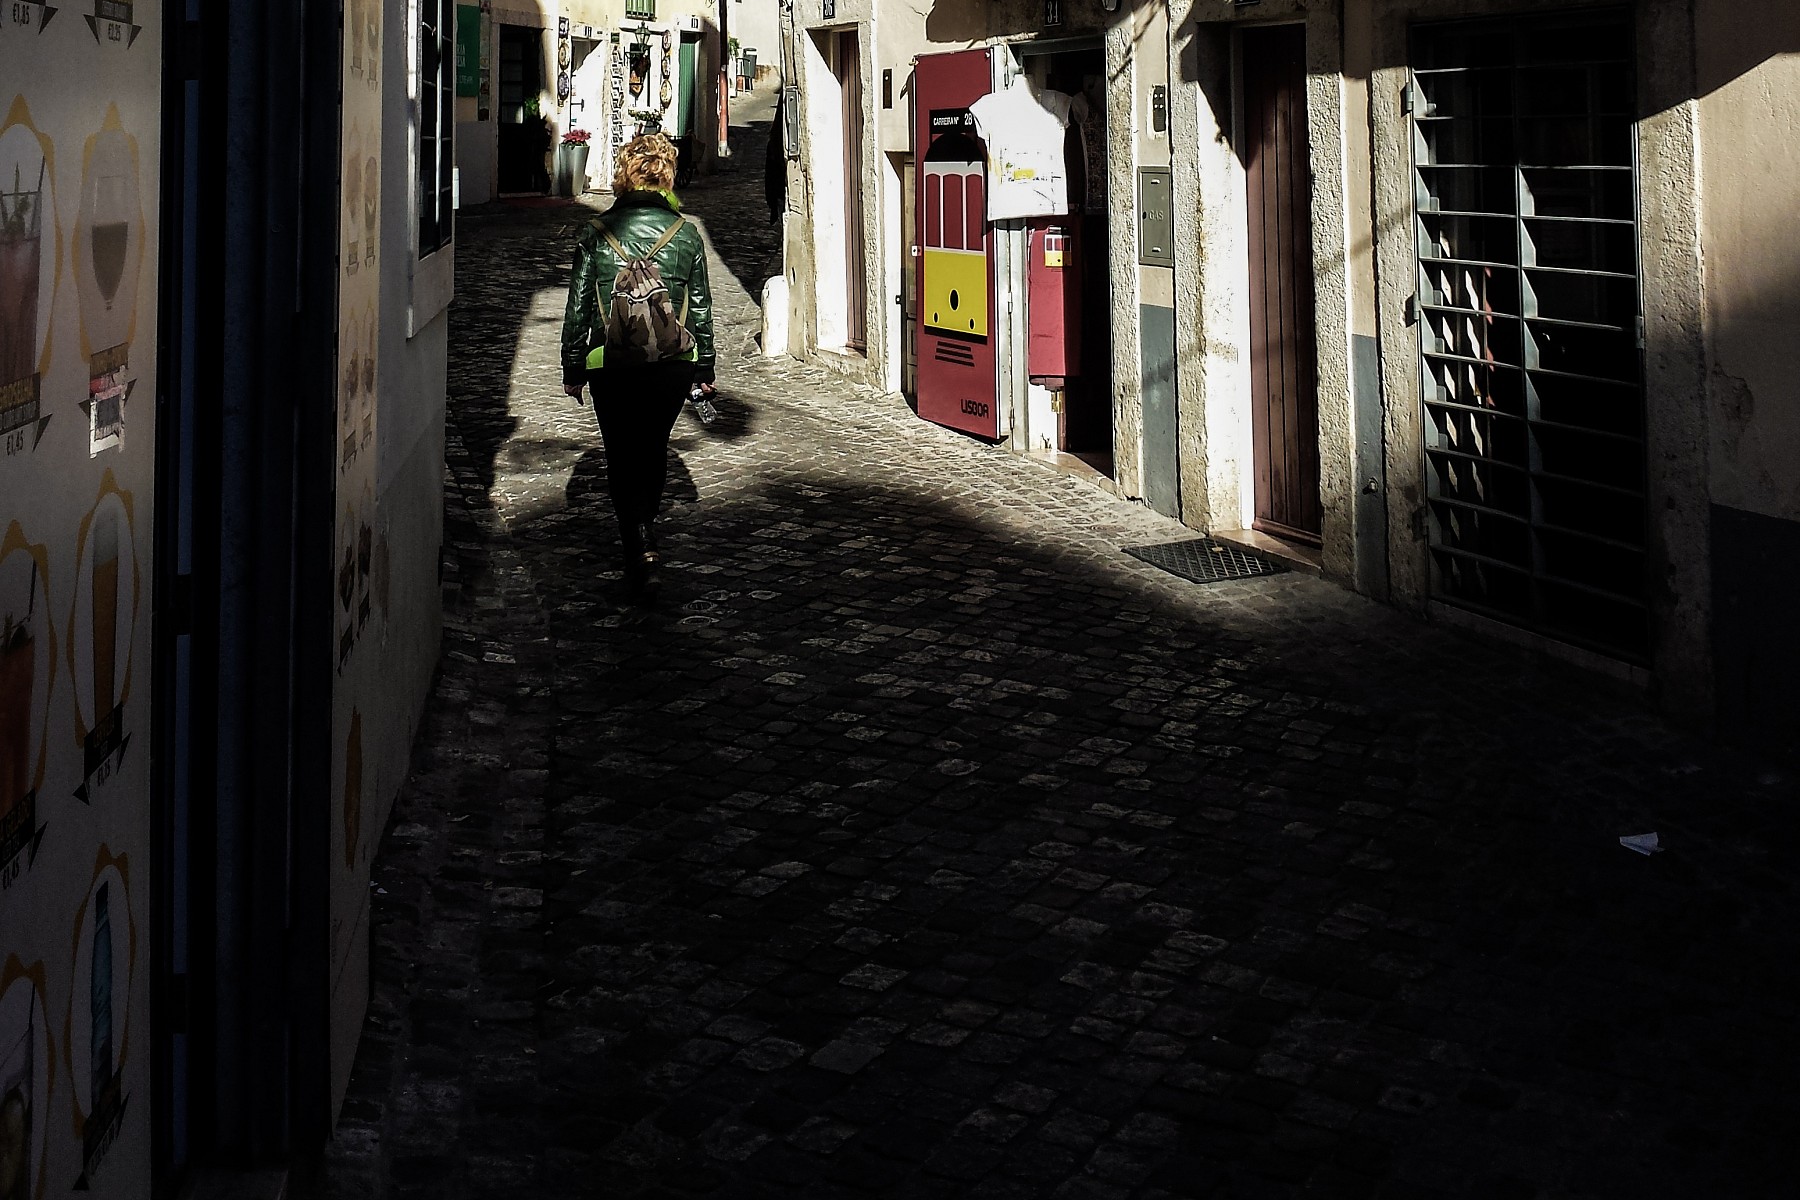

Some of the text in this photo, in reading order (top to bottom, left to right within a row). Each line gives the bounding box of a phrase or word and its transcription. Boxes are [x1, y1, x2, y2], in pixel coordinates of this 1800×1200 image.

[1046, 0, 1059, 23] 34
[933, 116, 953, 126] CARREIRA
[964, 113, 973, 126] 28
[1148, 210, 1163, 221] GAS
[960, 398, 989, 419] LISBOA
